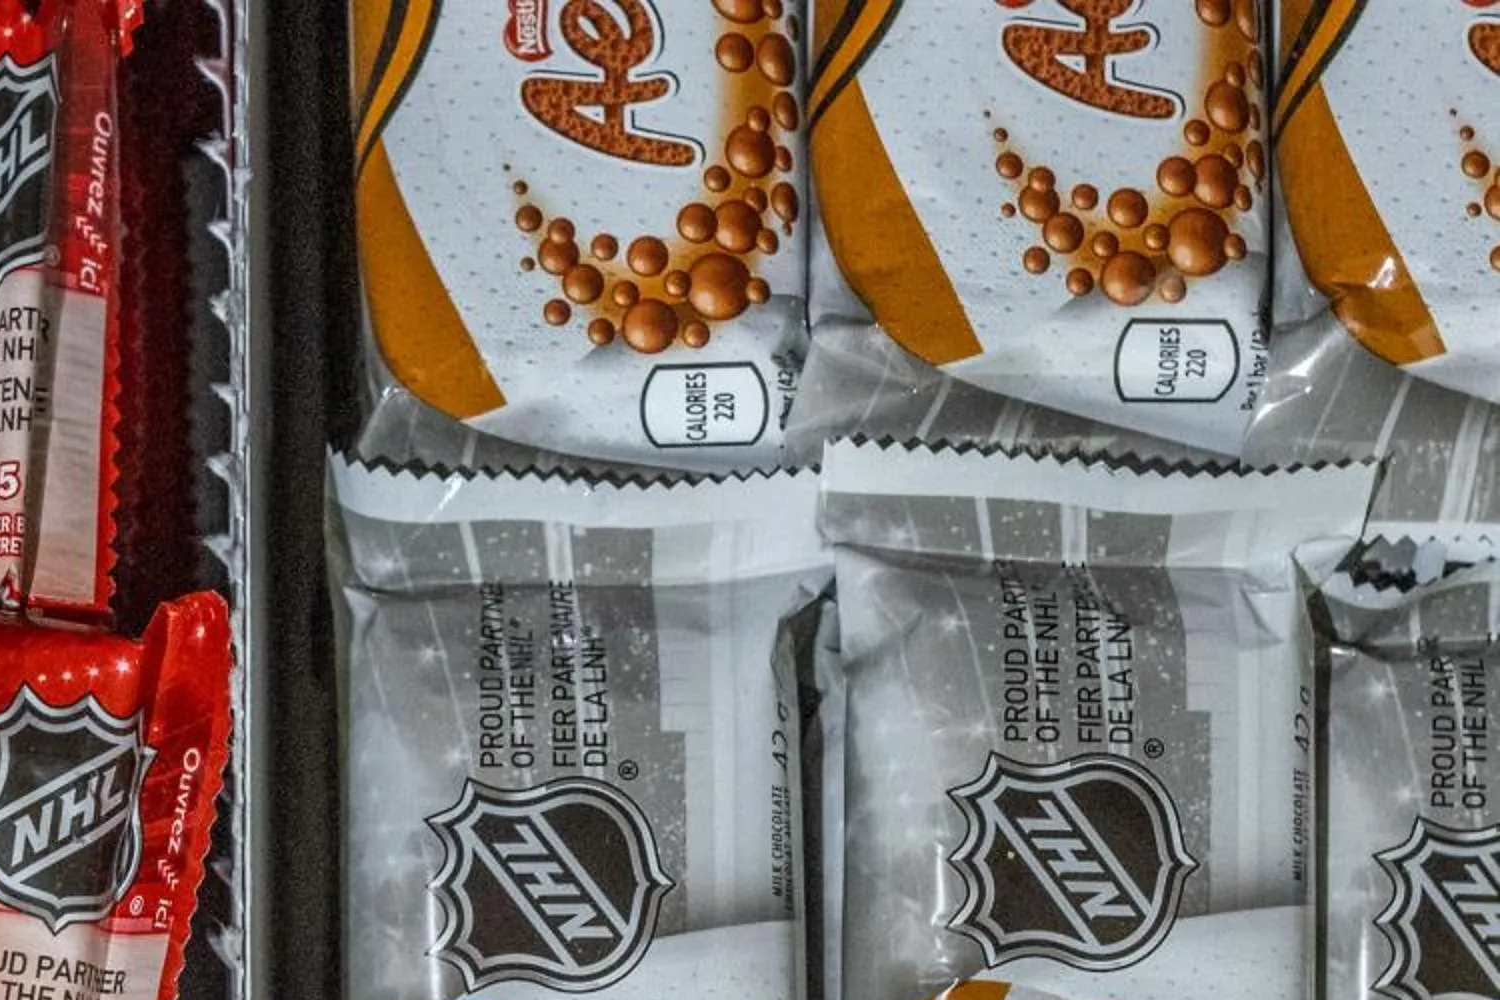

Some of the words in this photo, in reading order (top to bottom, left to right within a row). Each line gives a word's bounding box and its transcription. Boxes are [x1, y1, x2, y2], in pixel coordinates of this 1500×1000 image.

[88, 112, 113, 217] Ouvrez
[1155, 327, 1182, 397] CALORIES
[1187, 348, 1208, 380] 220
[686, 371, 708, 443] CALORIES
[714, 392, 736, 422] 220
[510, 673, 535, 727] THE
[1003, 649, 1029, 743] PROUD
[1035, 648, 1060, 702] THE
[1107, 668, 1132, 702] LA
[479, 677, 504, 769] PROUD
[582, 689, 608, 724] LA
[1035, 707, 1060, 743] OF
[1077, 686, 1103, 743] FIER
[1107, 708, 1133, 744] DE
[510, 731, 535, 769] OF
[551, 709, 577, 768] FIER
[582, 731, 608, 768] DE
[1430, 715, 1456, 809] PROUD
[1461, 714, 1487, 767] THE
[11, 766, 126, 867] NHL
[167, 747, 201, 855] Ouvrez
[1461, 774, 1487, 810] OF
[771, 783, 784, 860] CHOCOLATE
[493, 823, 614, 942] NHL
[771, 863, 783, 898] MILK
[1017, 800, 1140, 921] NHL
